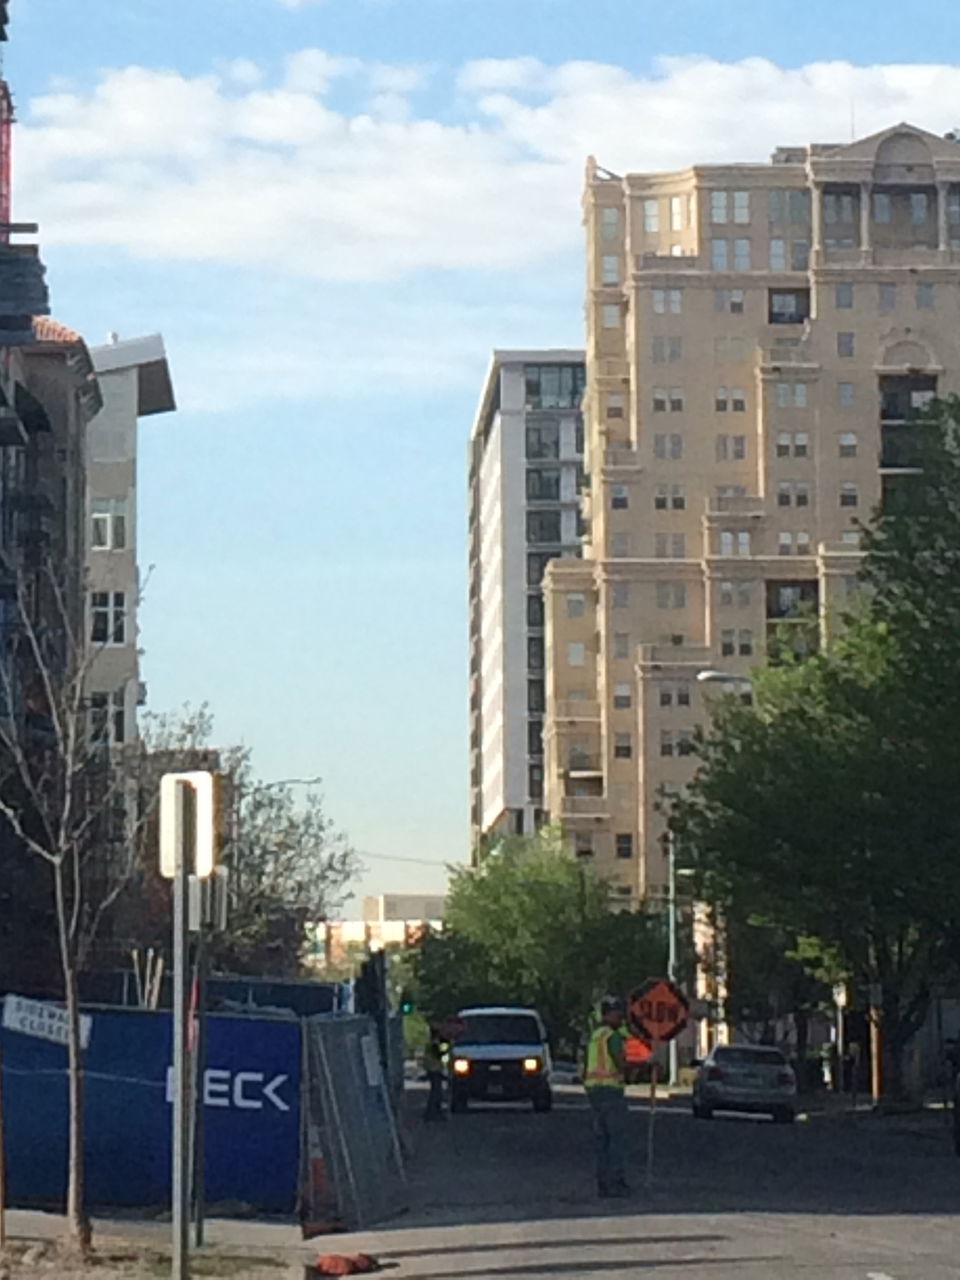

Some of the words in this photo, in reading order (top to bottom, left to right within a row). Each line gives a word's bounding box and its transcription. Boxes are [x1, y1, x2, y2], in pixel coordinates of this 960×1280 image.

[16, 1000, 70, 1025] SIDEWA
[639, 1000, 679, 1023] SLOW
[20, 1015, 70, 1040] CLOSE
